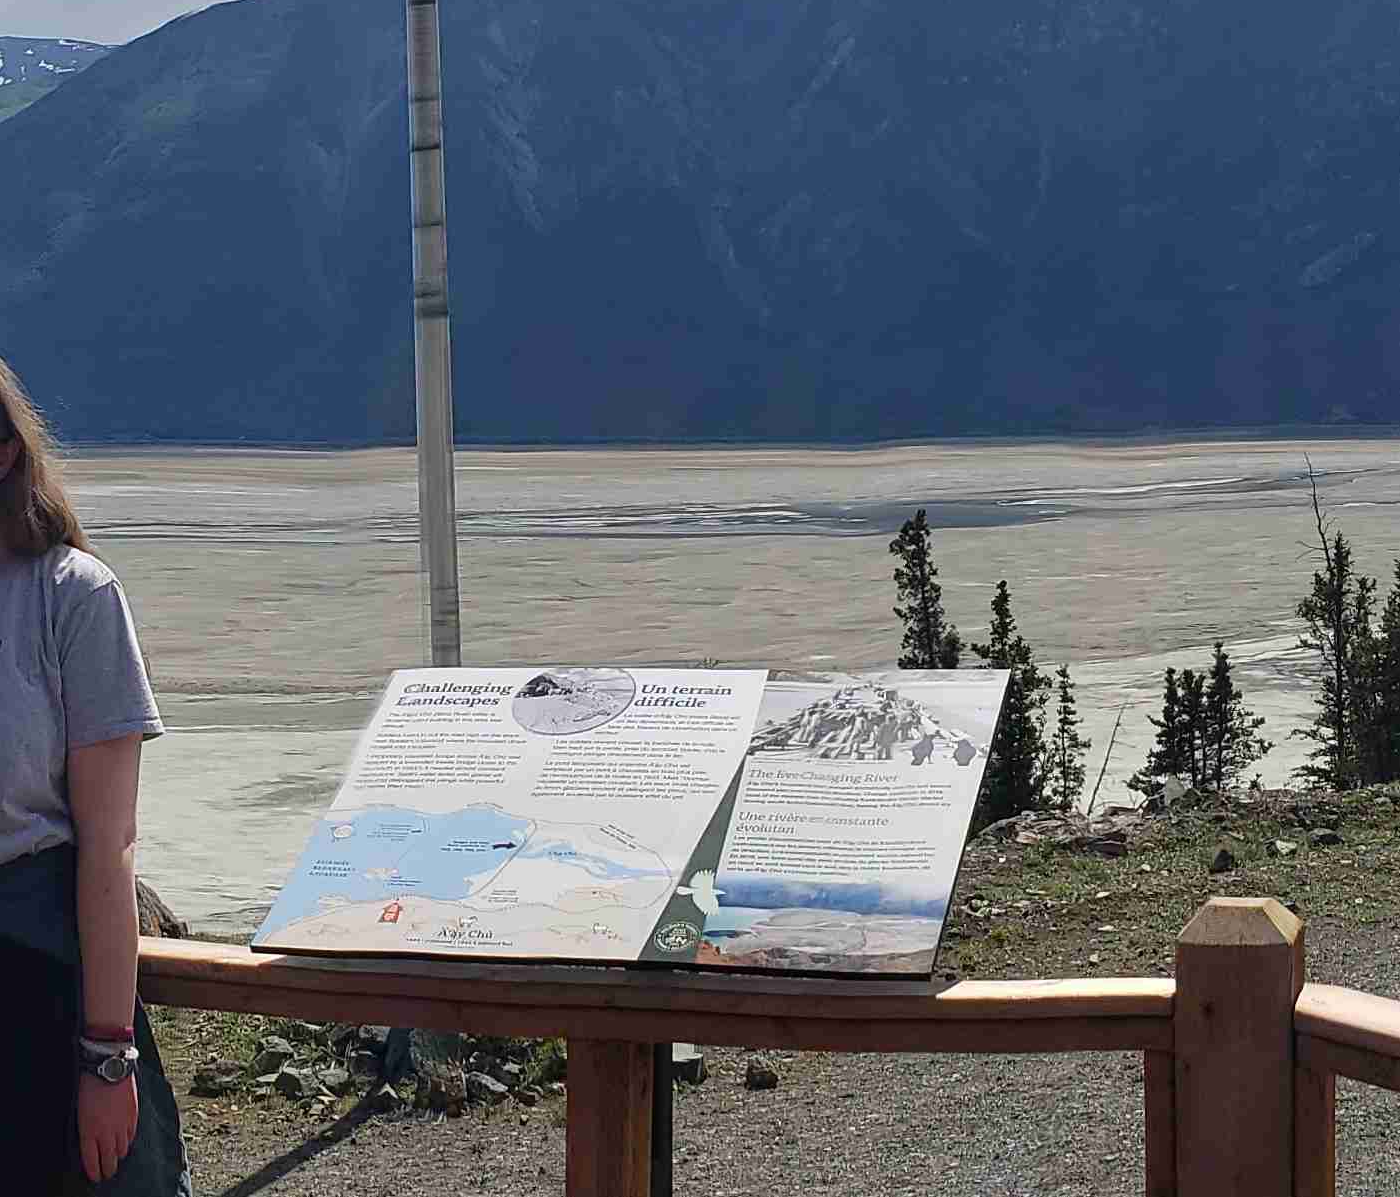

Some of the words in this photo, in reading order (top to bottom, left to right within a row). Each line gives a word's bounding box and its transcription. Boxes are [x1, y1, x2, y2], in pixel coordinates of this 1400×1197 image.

[403, 681, 514, 696] Challenging
[640, 683, 669, 695] Un
[670, 684, 733, 696] terrain
[396, 695, 501, 708] Landscapes
[633, 696, 708, 709] difficile
[748, 769, 775, 780] The
[863, 773, 900, 784] River
[738, 811, 767, 822] Une
